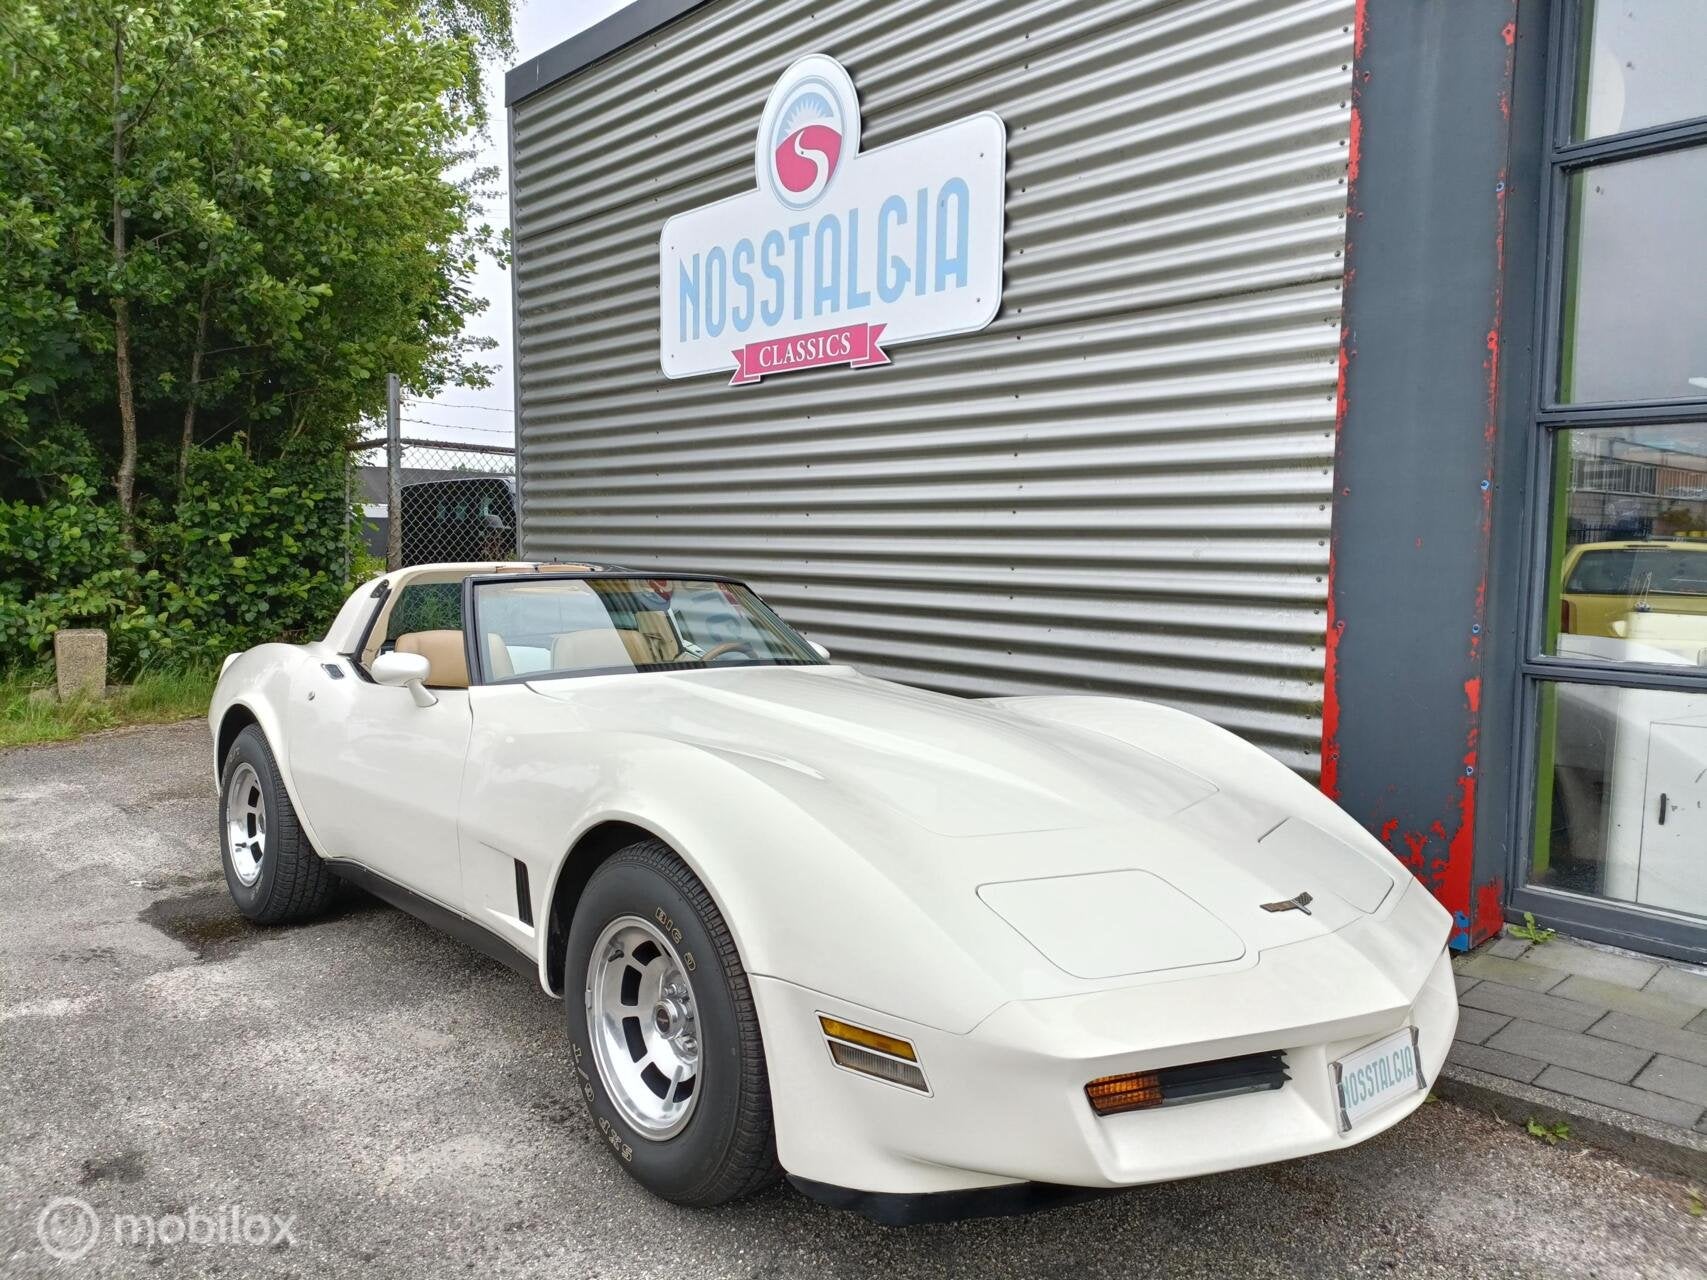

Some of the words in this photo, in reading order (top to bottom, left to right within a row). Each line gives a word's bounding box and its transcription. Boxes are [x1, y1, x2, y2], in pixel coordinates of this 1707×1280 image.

[679, 177, 970, 343] NOSSTALGIA
[759, 332, 851, 368] CLASSICS
[1341, 1045, 1414, 1109] NOSSTALGIA
